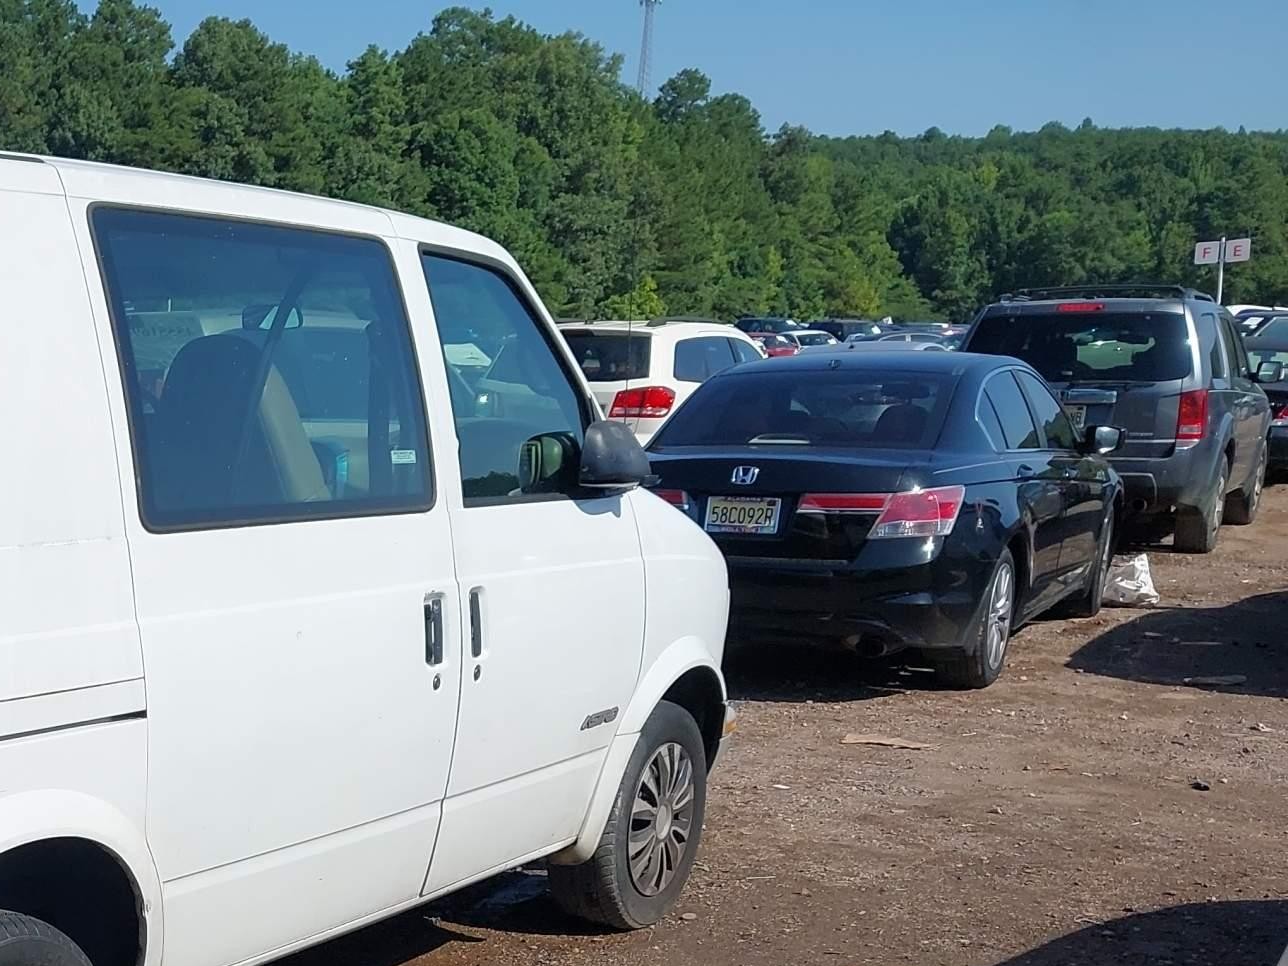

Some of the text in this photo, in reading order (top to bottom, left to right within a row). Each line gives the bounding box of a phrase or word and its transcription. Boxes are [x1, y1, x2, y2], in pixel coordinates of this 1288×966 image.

[1202, 247, 1212, 259] F
[1233, 245, 1242, 257] E
[711, 505, 774, 525] 58C092R
